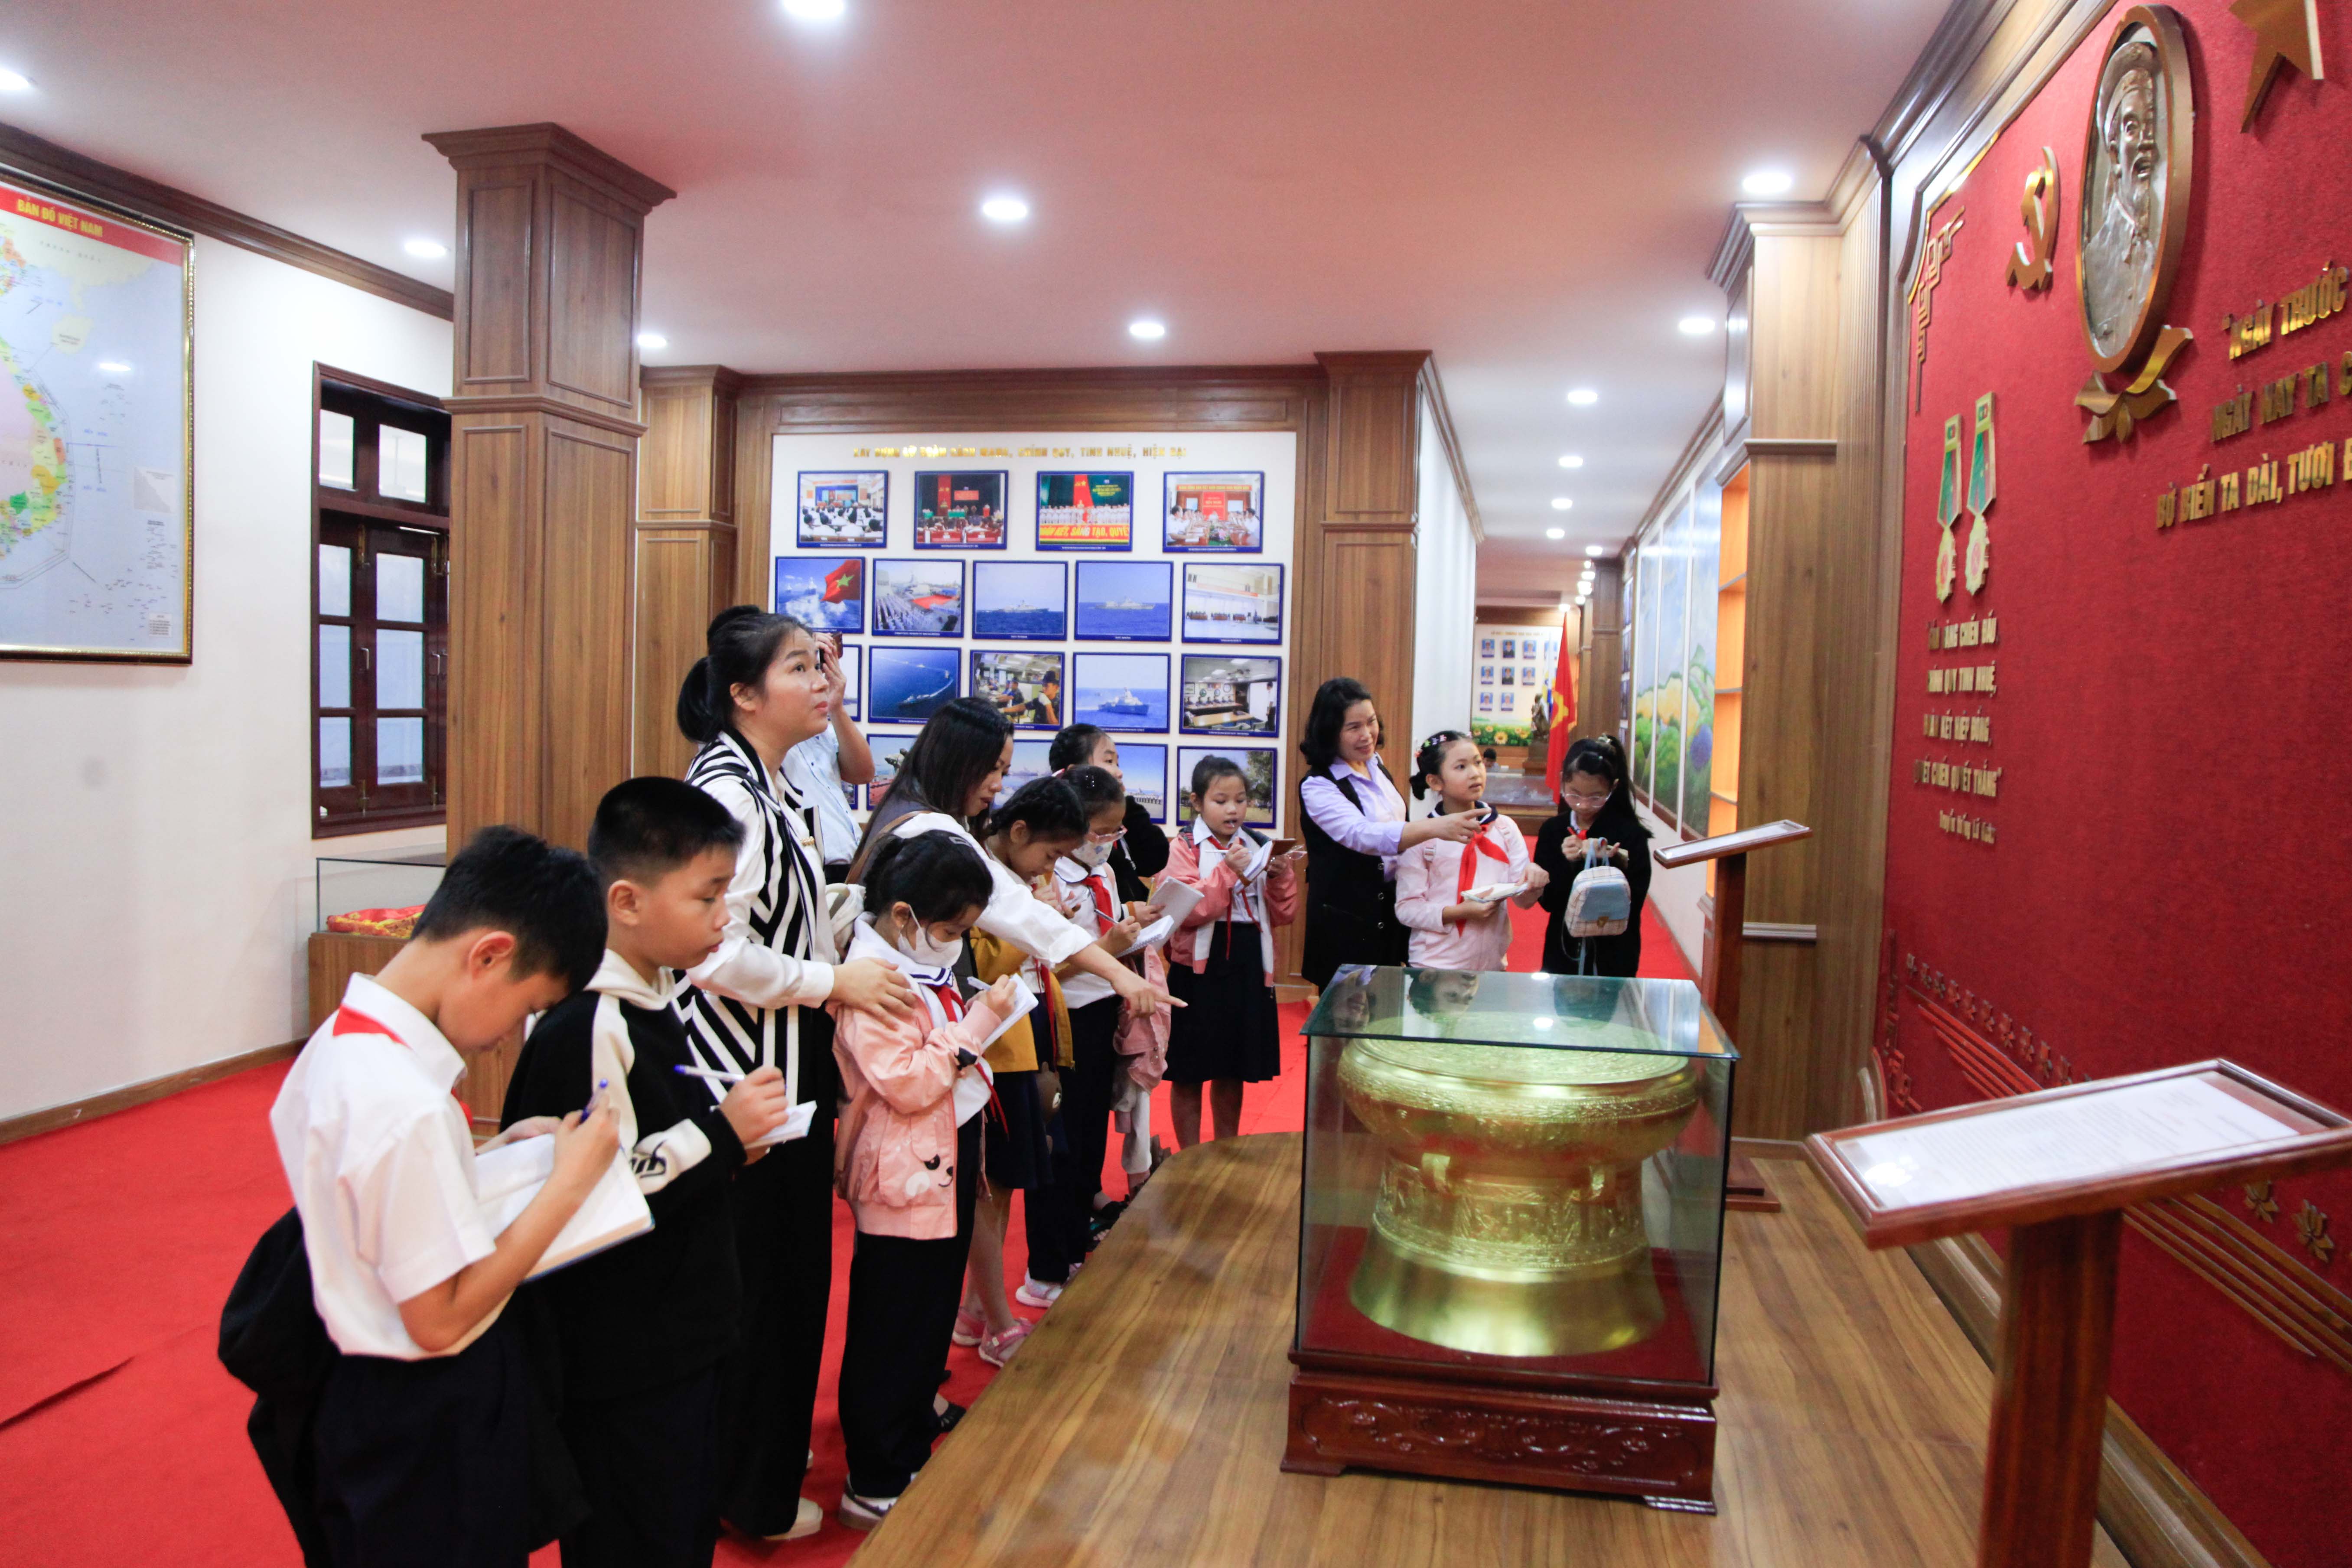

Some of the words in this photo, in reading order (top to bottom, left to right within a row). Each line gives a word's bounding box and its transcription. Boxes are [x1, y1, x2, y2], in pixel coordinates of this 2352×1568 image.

[18, 196, 39, 216] BẢN
[42, 206, 55, 222] ĐỒ
[58, 212, 78, 230] VIỆT
[81, 220, 102, 237] NAM
[1081, 447, 1102, 457] TINH
[2220, 472, 2240, 512] TA
